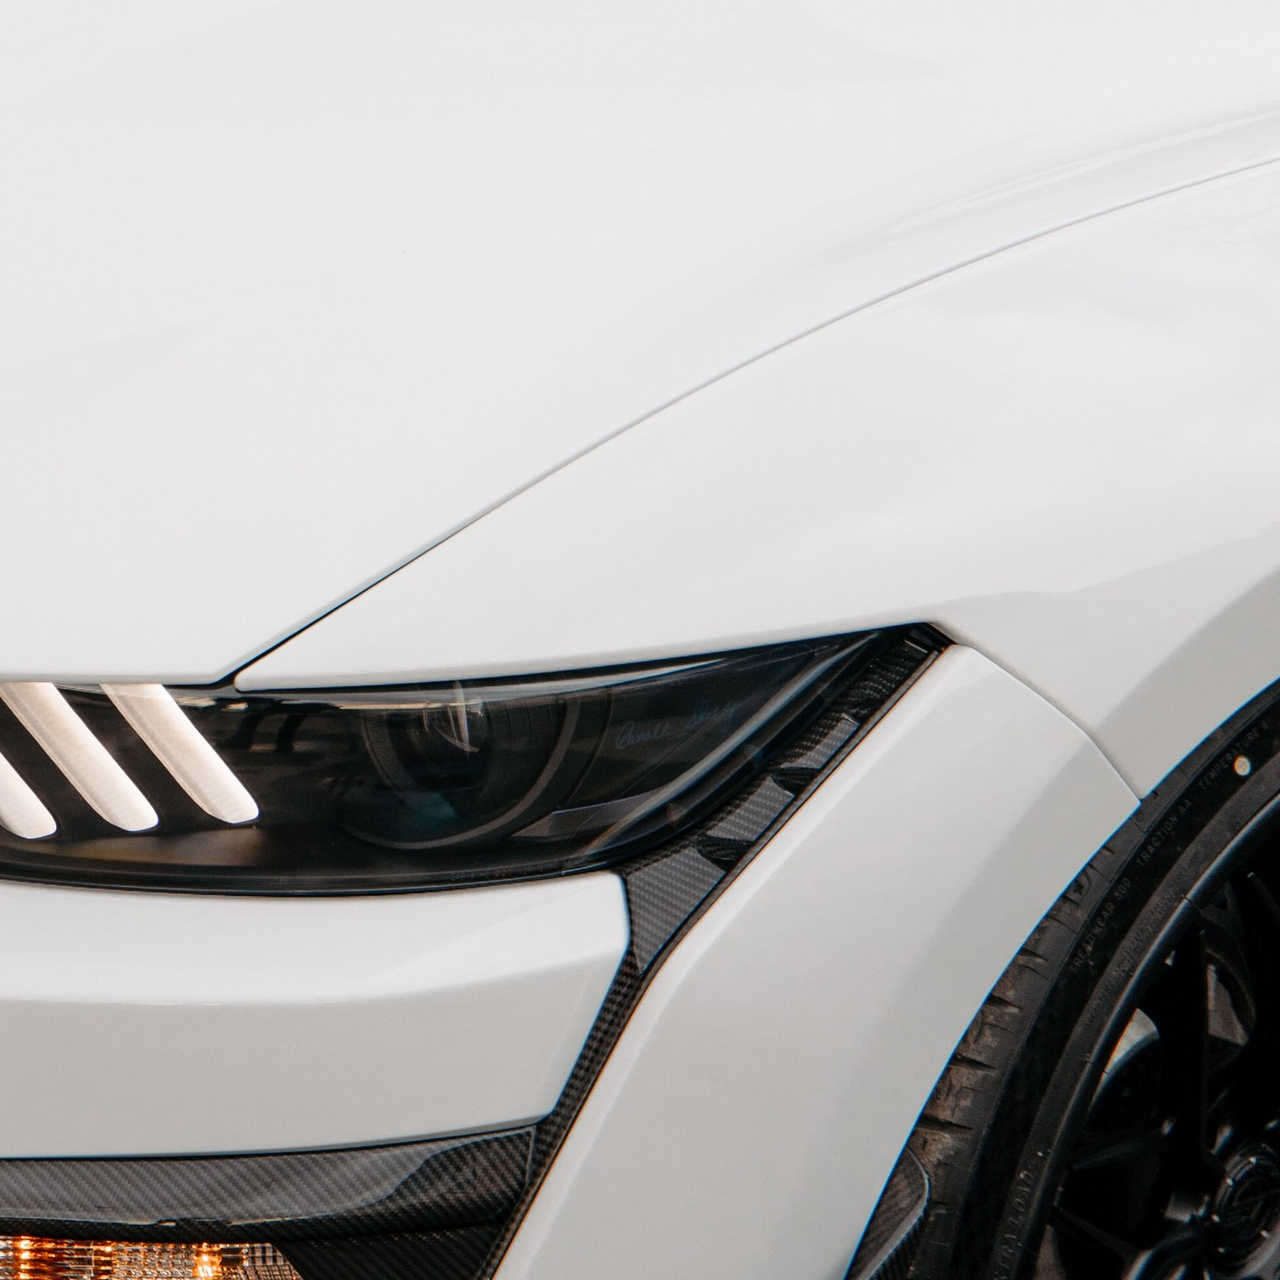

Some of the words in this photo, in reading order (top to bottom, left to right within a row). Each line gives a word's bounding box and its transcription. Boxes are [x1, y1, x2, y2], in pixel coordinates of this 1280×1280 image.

[1070, 899, 1117, 975] TREADWEAR
[1136, 819, 1180, 867] TRACTION
[1197, 726, 1262, 791] TEMPERATURE
